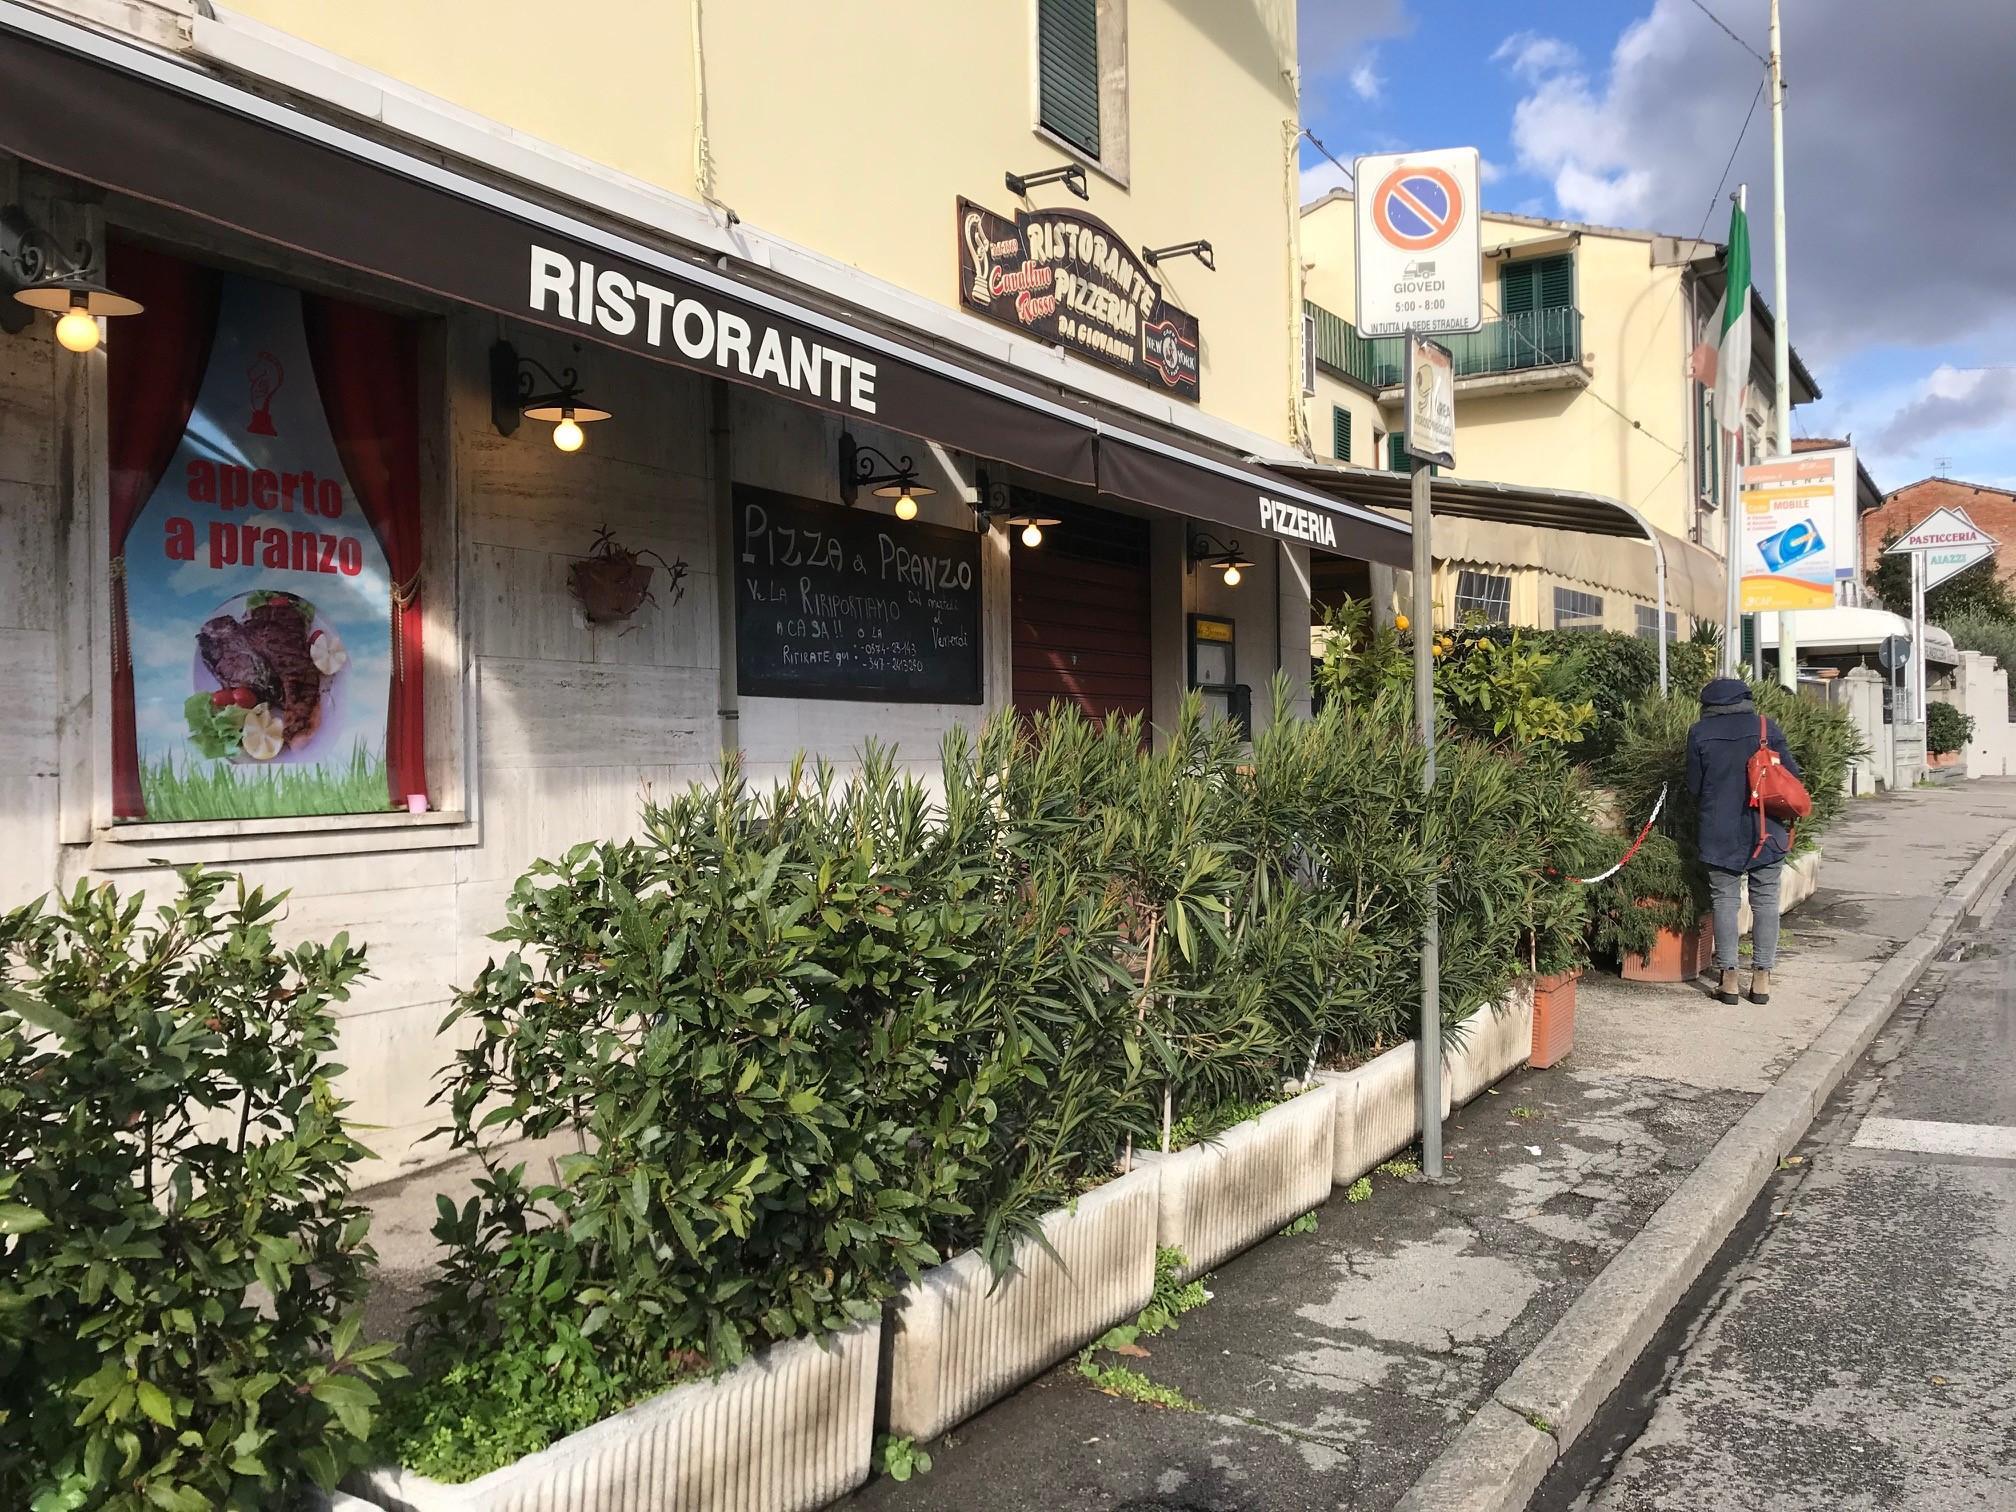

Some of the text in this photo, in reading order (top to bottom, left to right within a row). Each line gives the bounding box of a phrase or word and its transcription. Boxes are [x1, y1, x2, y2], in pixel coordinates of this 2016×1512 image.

[990, 259, 1052, 296] Cavallino
[1027, 222, 1156, 321] RISTORANTE
[1394, 280, 1446, 294] GIOVEDI
[1015, 289, 1055, 325] Rosso
[1054, 268, 1136, 337] PIZZERIA
[1395, 301, 1416, 313] 5:00
[1424, 299, 1445, 310] 8:00
[529, 243, 878, 415] RISTORANTE
[1058, 315, 1135, 365] DA GIOVANNI
[1370, 318, 1469, 333] IN TUTTA LA SEDE STRADALE
[1146, 336, 1162, 354] NEW
[1177, 350, 1195, 371] YORK
[185, 457, 344, 520] aperto
[1773, 499, 1810, 510] MOBILE
[1258, 496, 1337, 548] PIZZERIA
[1909, 531, 1978, 545] PASTICCERIA
[163, 518, 364, 577] a pranzo
[742, 503, 843, 573] PIZZA
[879, 533, 972, 594] PRANZO
[783, 645, 830, 665] RITIRATE
